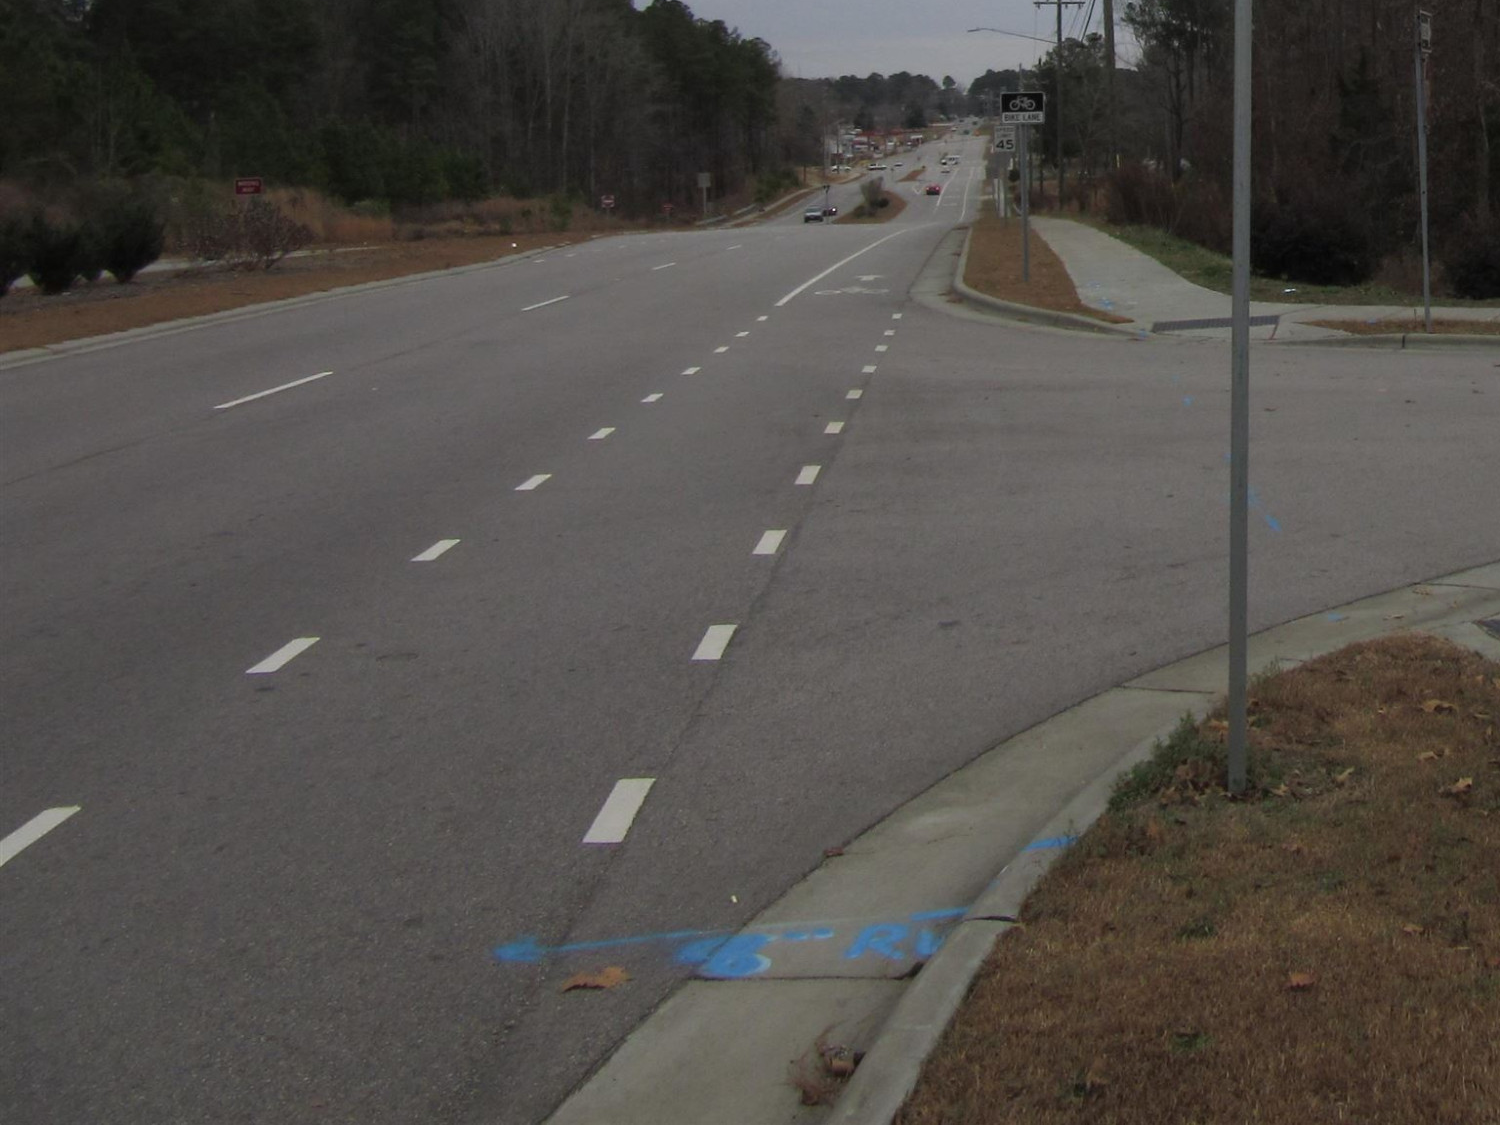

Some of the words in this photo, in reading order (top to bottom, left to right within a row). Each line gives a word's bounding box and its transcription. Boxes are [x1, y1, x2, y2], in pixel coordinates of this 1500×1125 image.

[1004, 114, 1021, 122] BIKE
[1022, 113, 1041, 121] LANE
[996, 139, 1014, 150] 45
